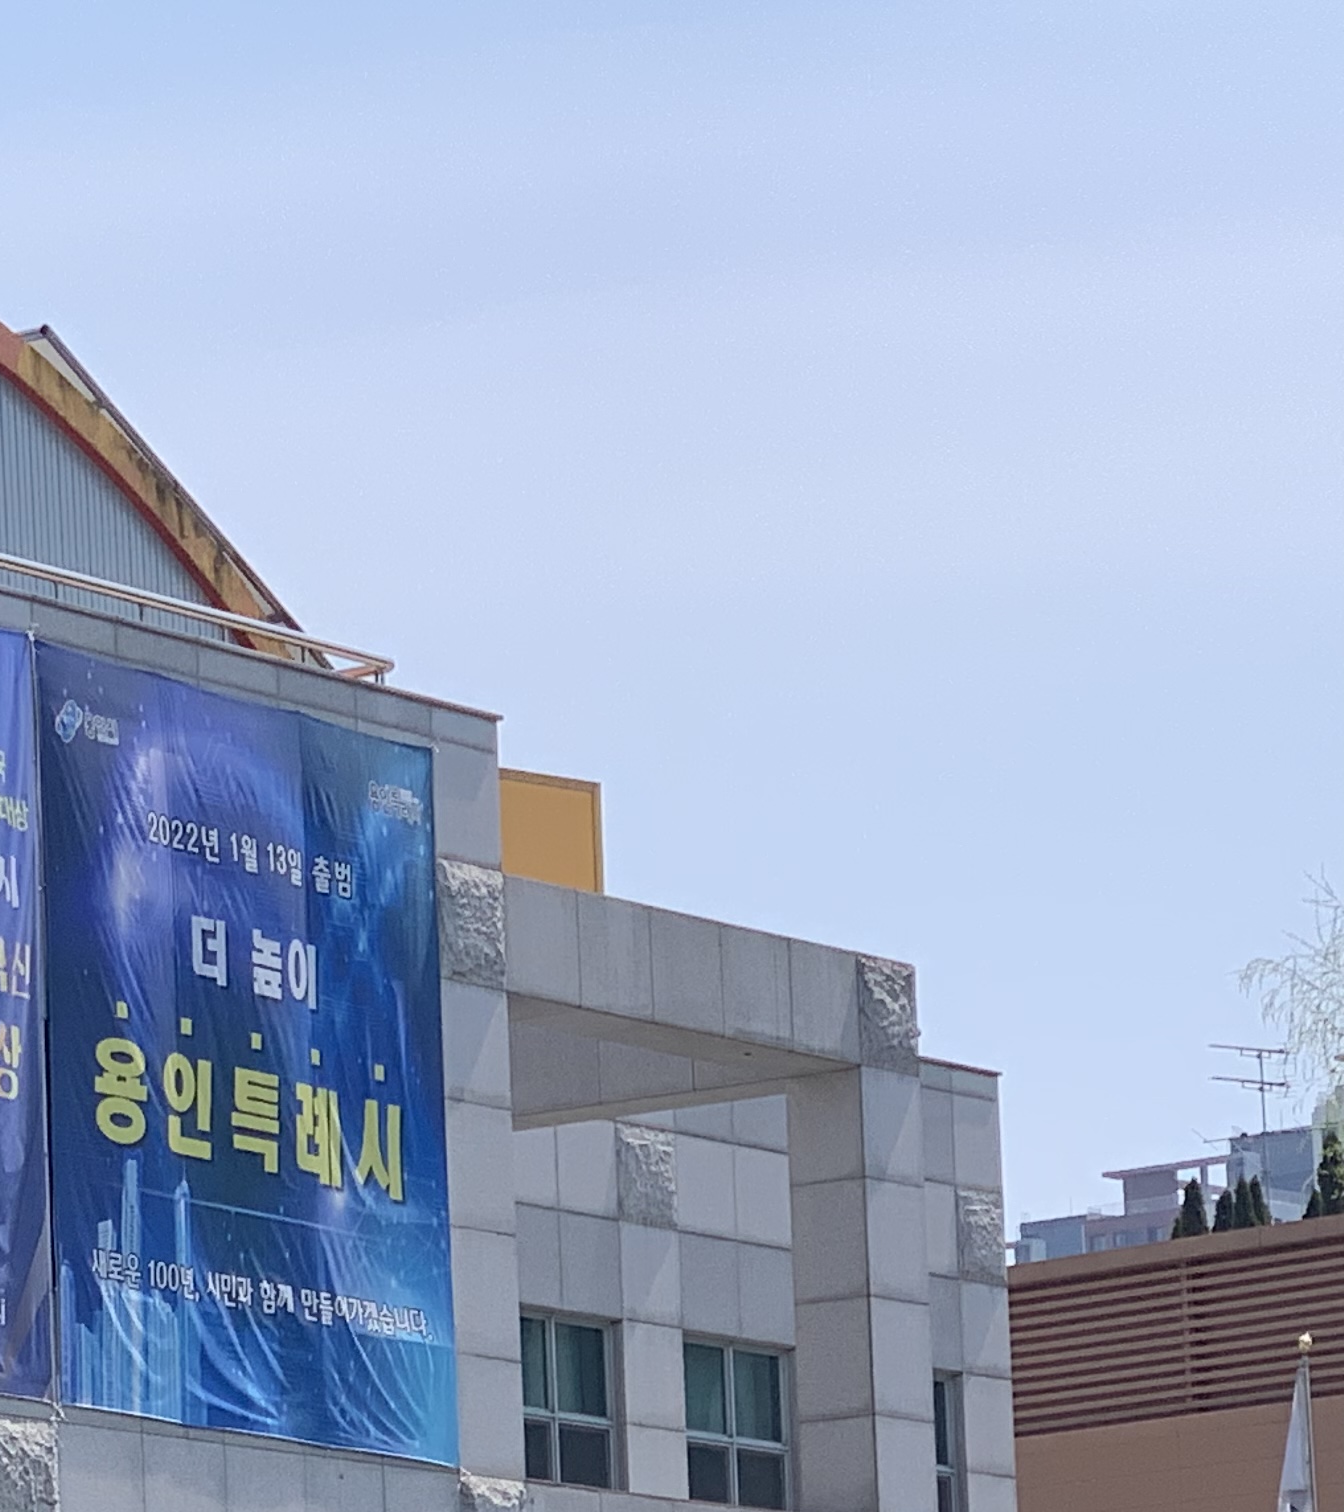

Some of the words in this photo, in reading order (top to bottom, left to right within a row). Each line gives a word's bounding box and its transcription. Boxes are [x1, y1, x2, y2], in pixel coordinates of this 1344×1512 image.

[146, 811, 221, 864] 2022년
[230, 832, 259, 874] 1월
[266, 841, 303, 888] 13일
[311, 855, 354, 899] 출범
[191, 914, 229, 988] 더
[252, 927, 317, 1010] 높이
[94, 1036, 404, 1201] 용인특례시
[91, 1248, 141, 1290] 새로운
[206, 1270, 254, 1308] 시민과
[258, 1279, 295, 1315] 함께
